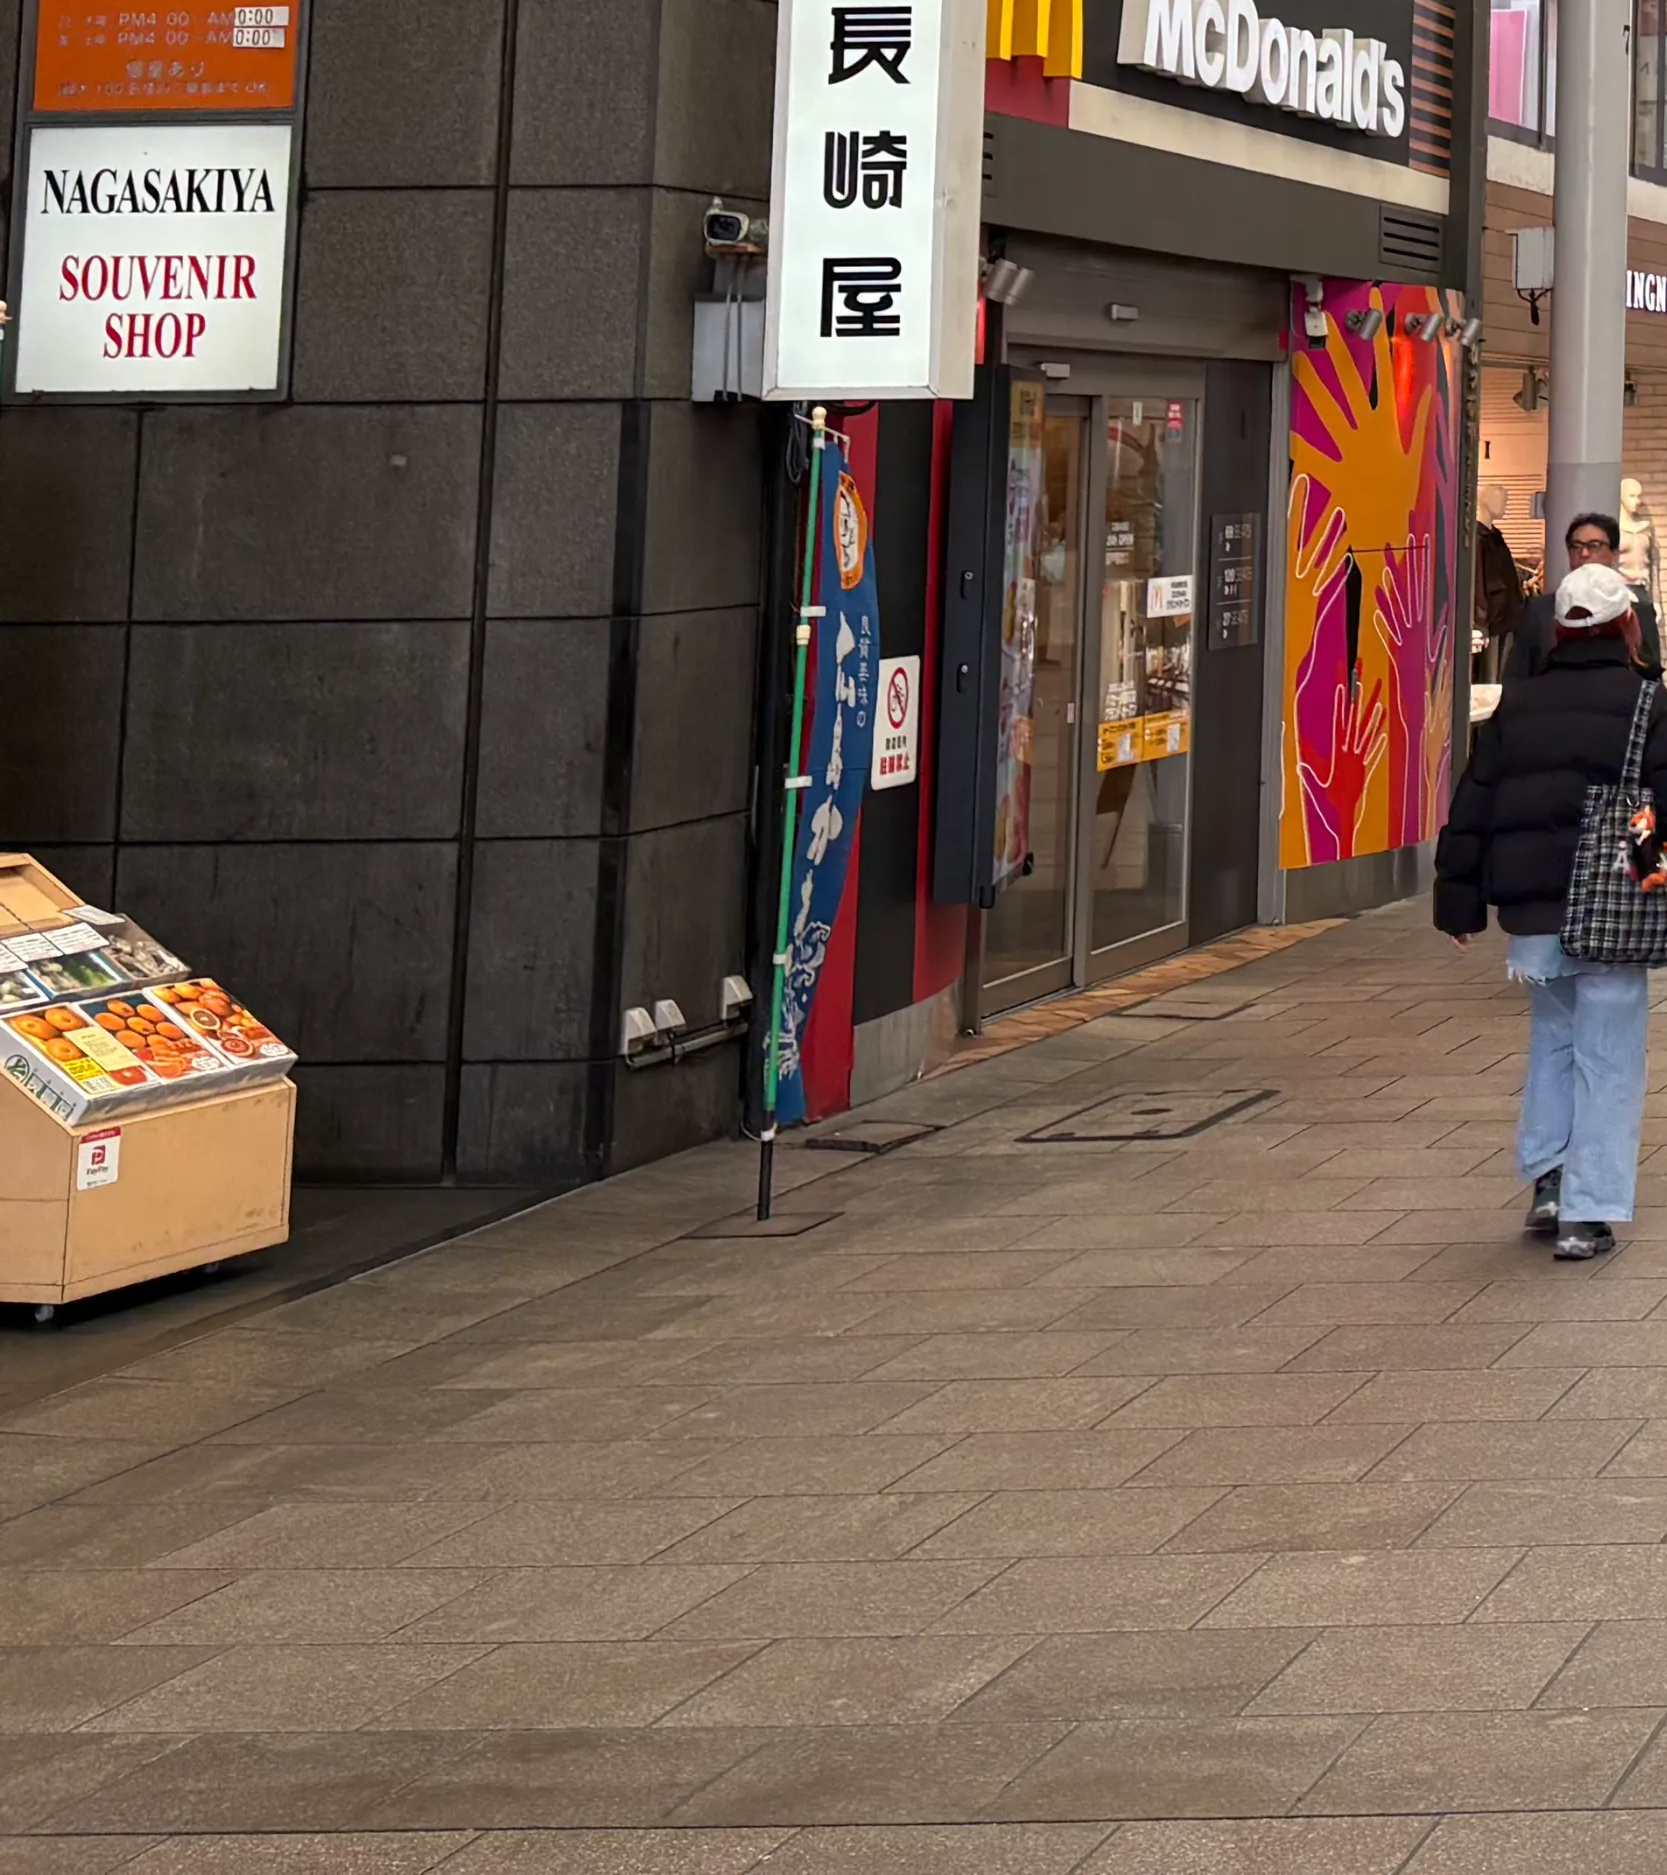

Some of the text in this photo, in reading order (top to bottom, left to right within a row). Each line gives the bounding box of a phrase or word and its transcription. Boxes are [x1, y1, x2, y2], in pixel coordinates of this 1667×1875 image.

[41, 164, 276, 216] NAGASAKIYA
[820, 5, 913, 339] 長崎屋
[58, 252, 257, 304] SOUVENIR
[103, 312, 206, 363] SHOP
